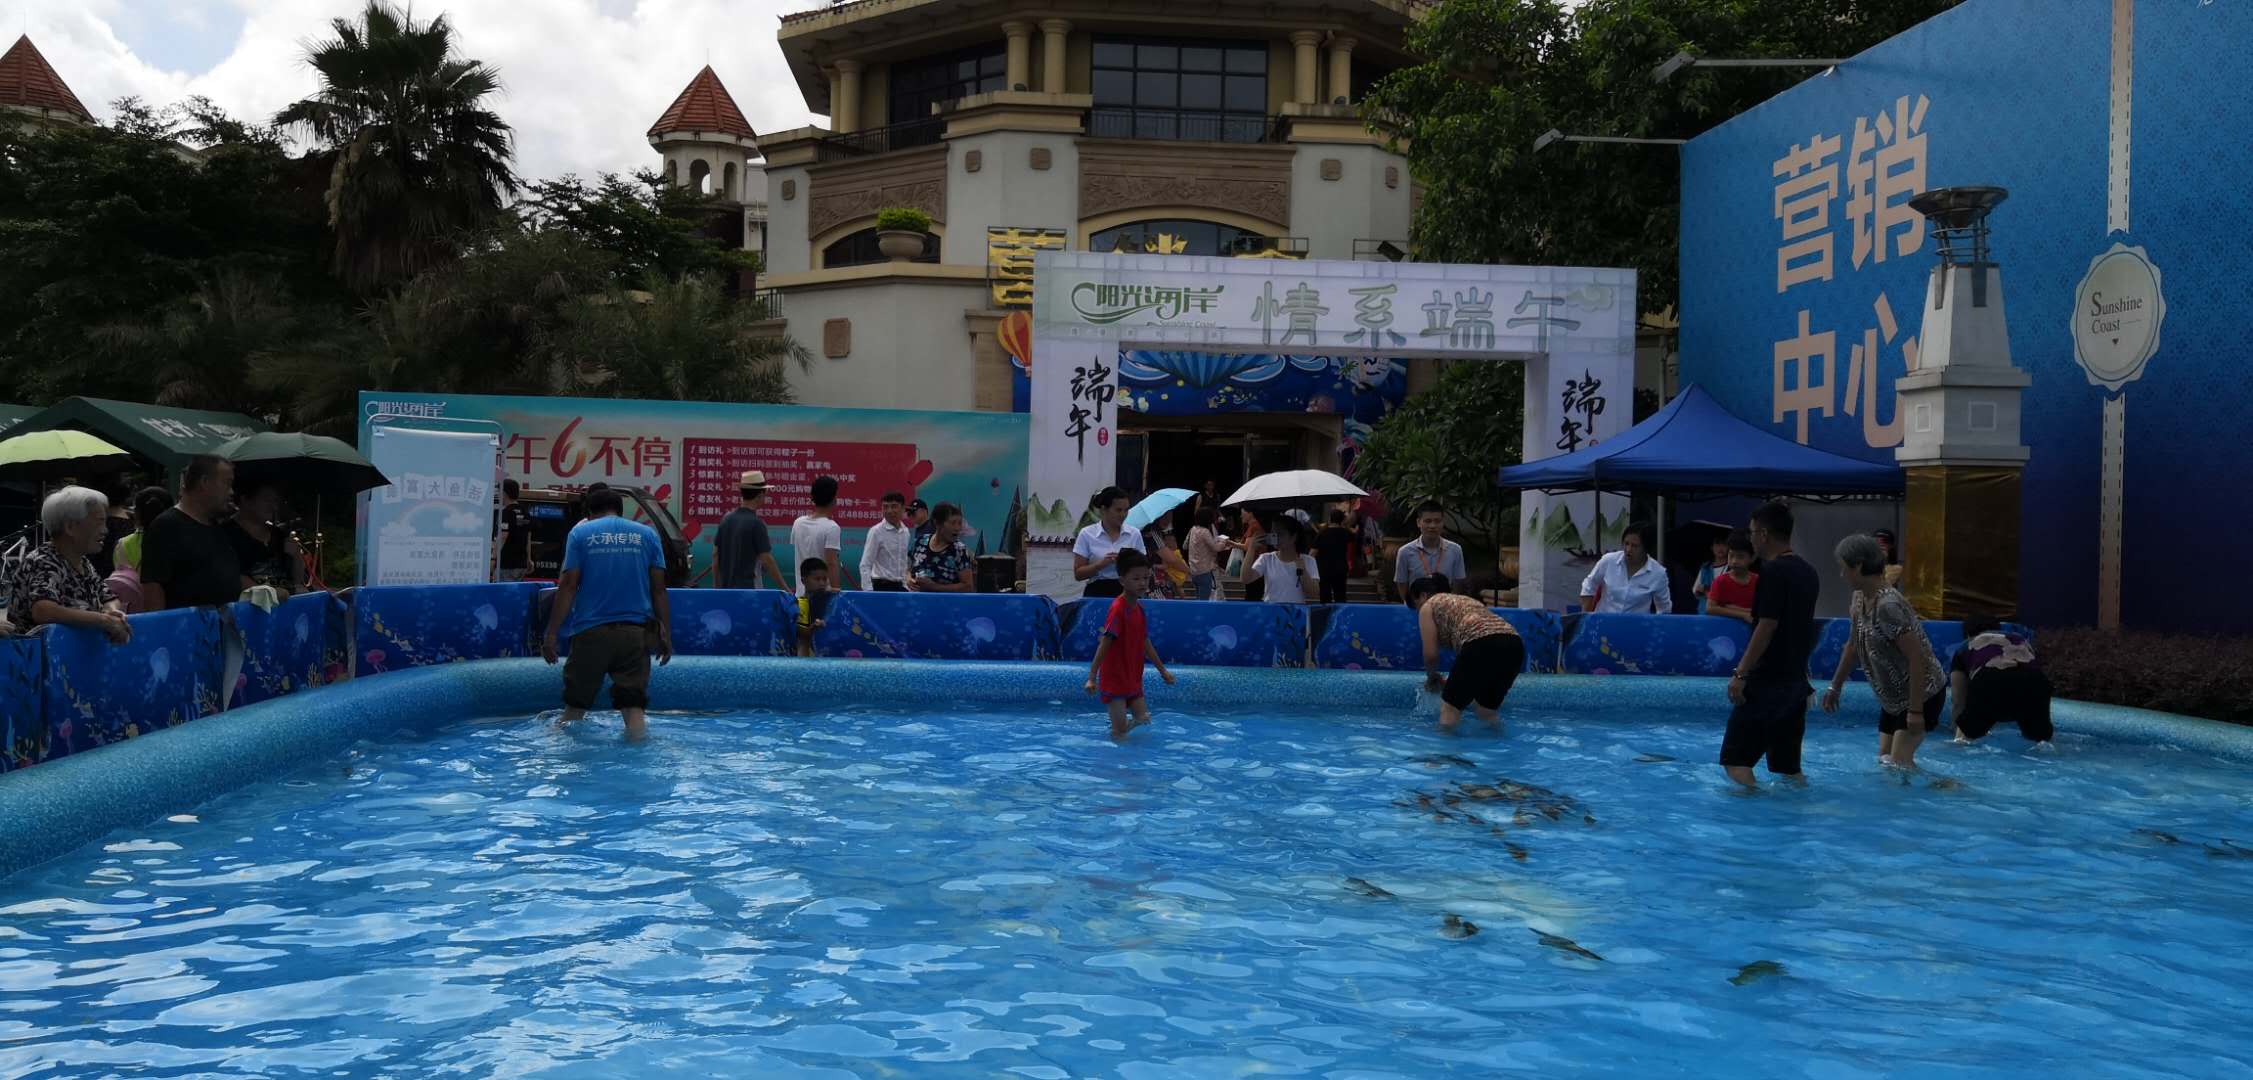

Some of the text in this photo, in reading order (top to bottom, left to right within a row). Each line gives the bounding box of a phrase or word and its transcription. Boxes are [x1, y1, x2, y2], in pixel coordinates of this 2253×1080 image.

[1772, 95, 1930, 294] 营销
[1071, 282, 1224, 322] 阳光海岸
[1251, 281, 1581, 352] 情系端午
[2090, 291, 2143, 317] Sunshine
[2091, 318, 2121, 335] Coast
[1773, 293, 1921, 448] 中心
[1065, 356, 1114, 465] 端午
[586, 532, 642, 546] 大承传媒
